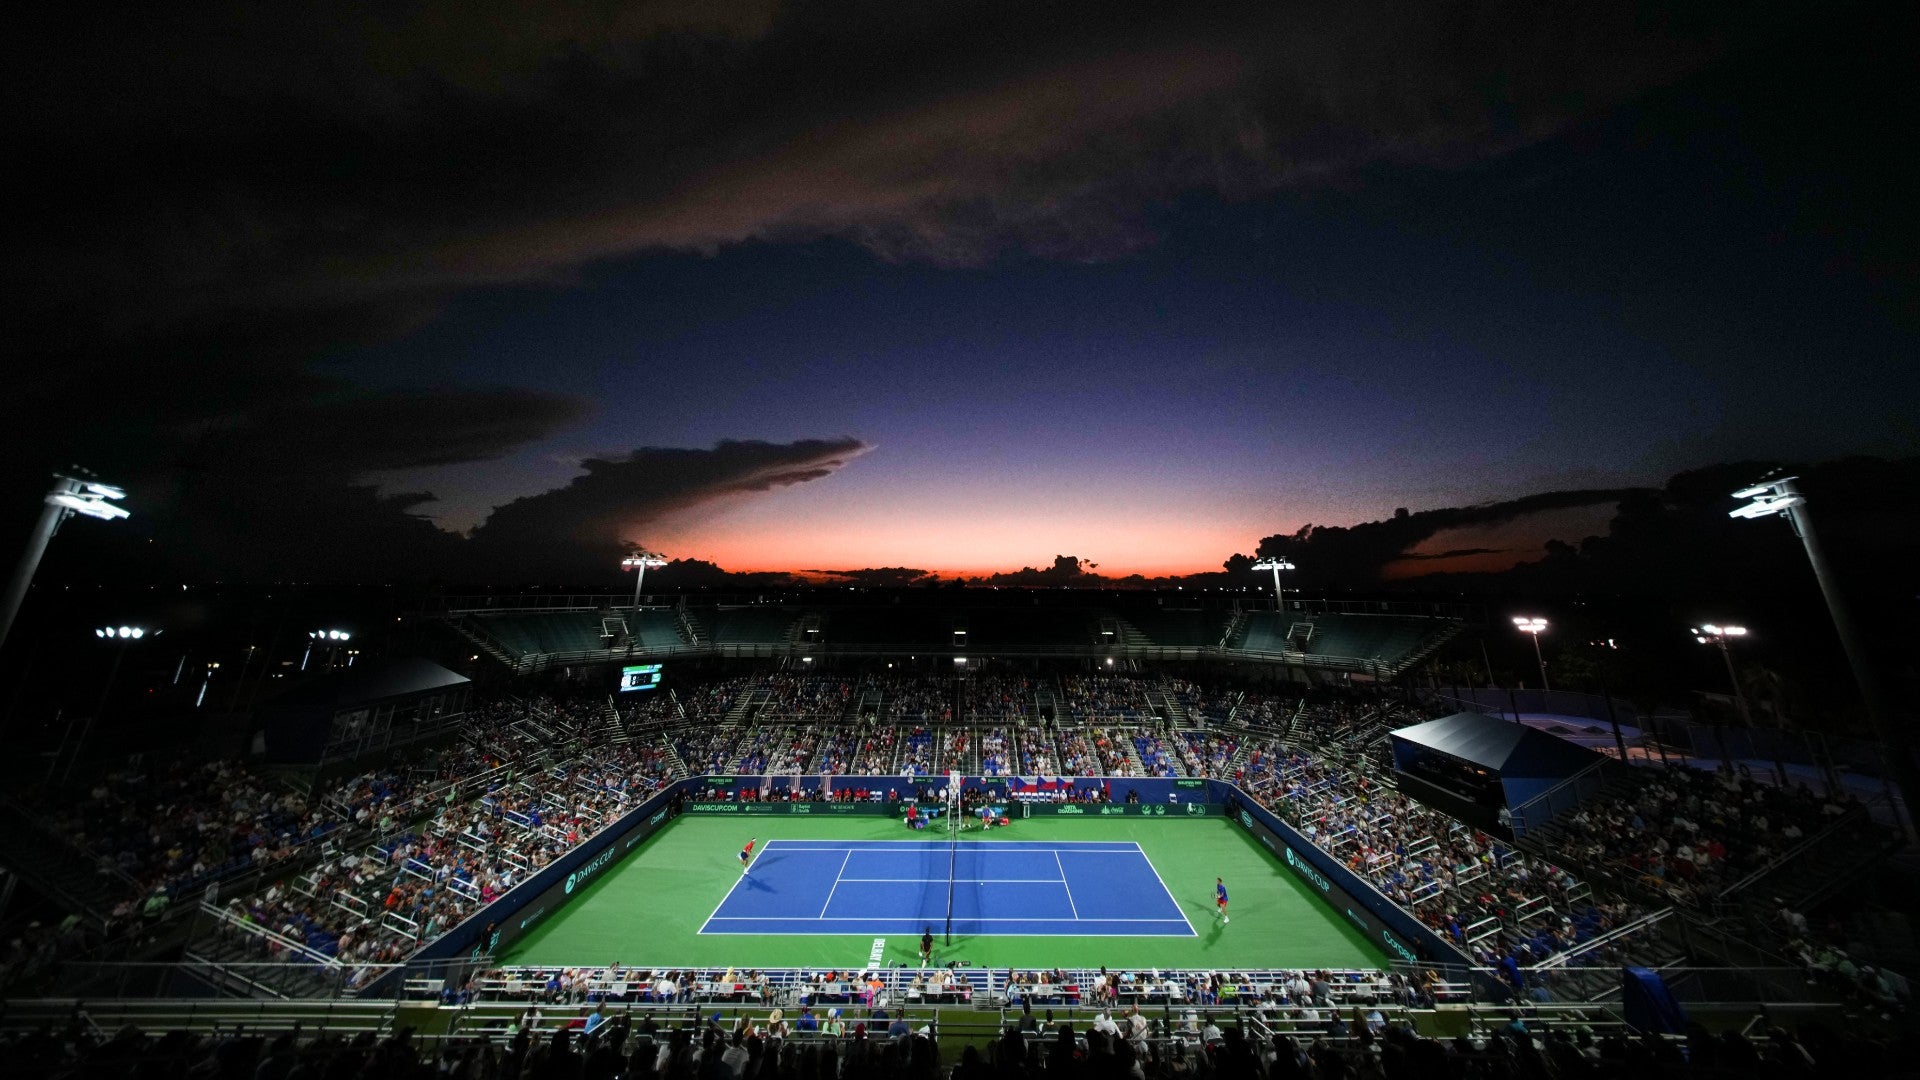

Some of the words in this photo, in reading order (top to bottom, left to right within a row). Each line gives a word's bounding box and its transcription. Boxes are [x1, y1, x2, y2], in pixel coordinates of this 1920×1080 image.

[577, 858, 599, 883] DAVIS
[599, 848, 615, 865] CUP
[1295, 856, 1314, 881] DAVIS
[1314, 873, 1329, 892] CUP
